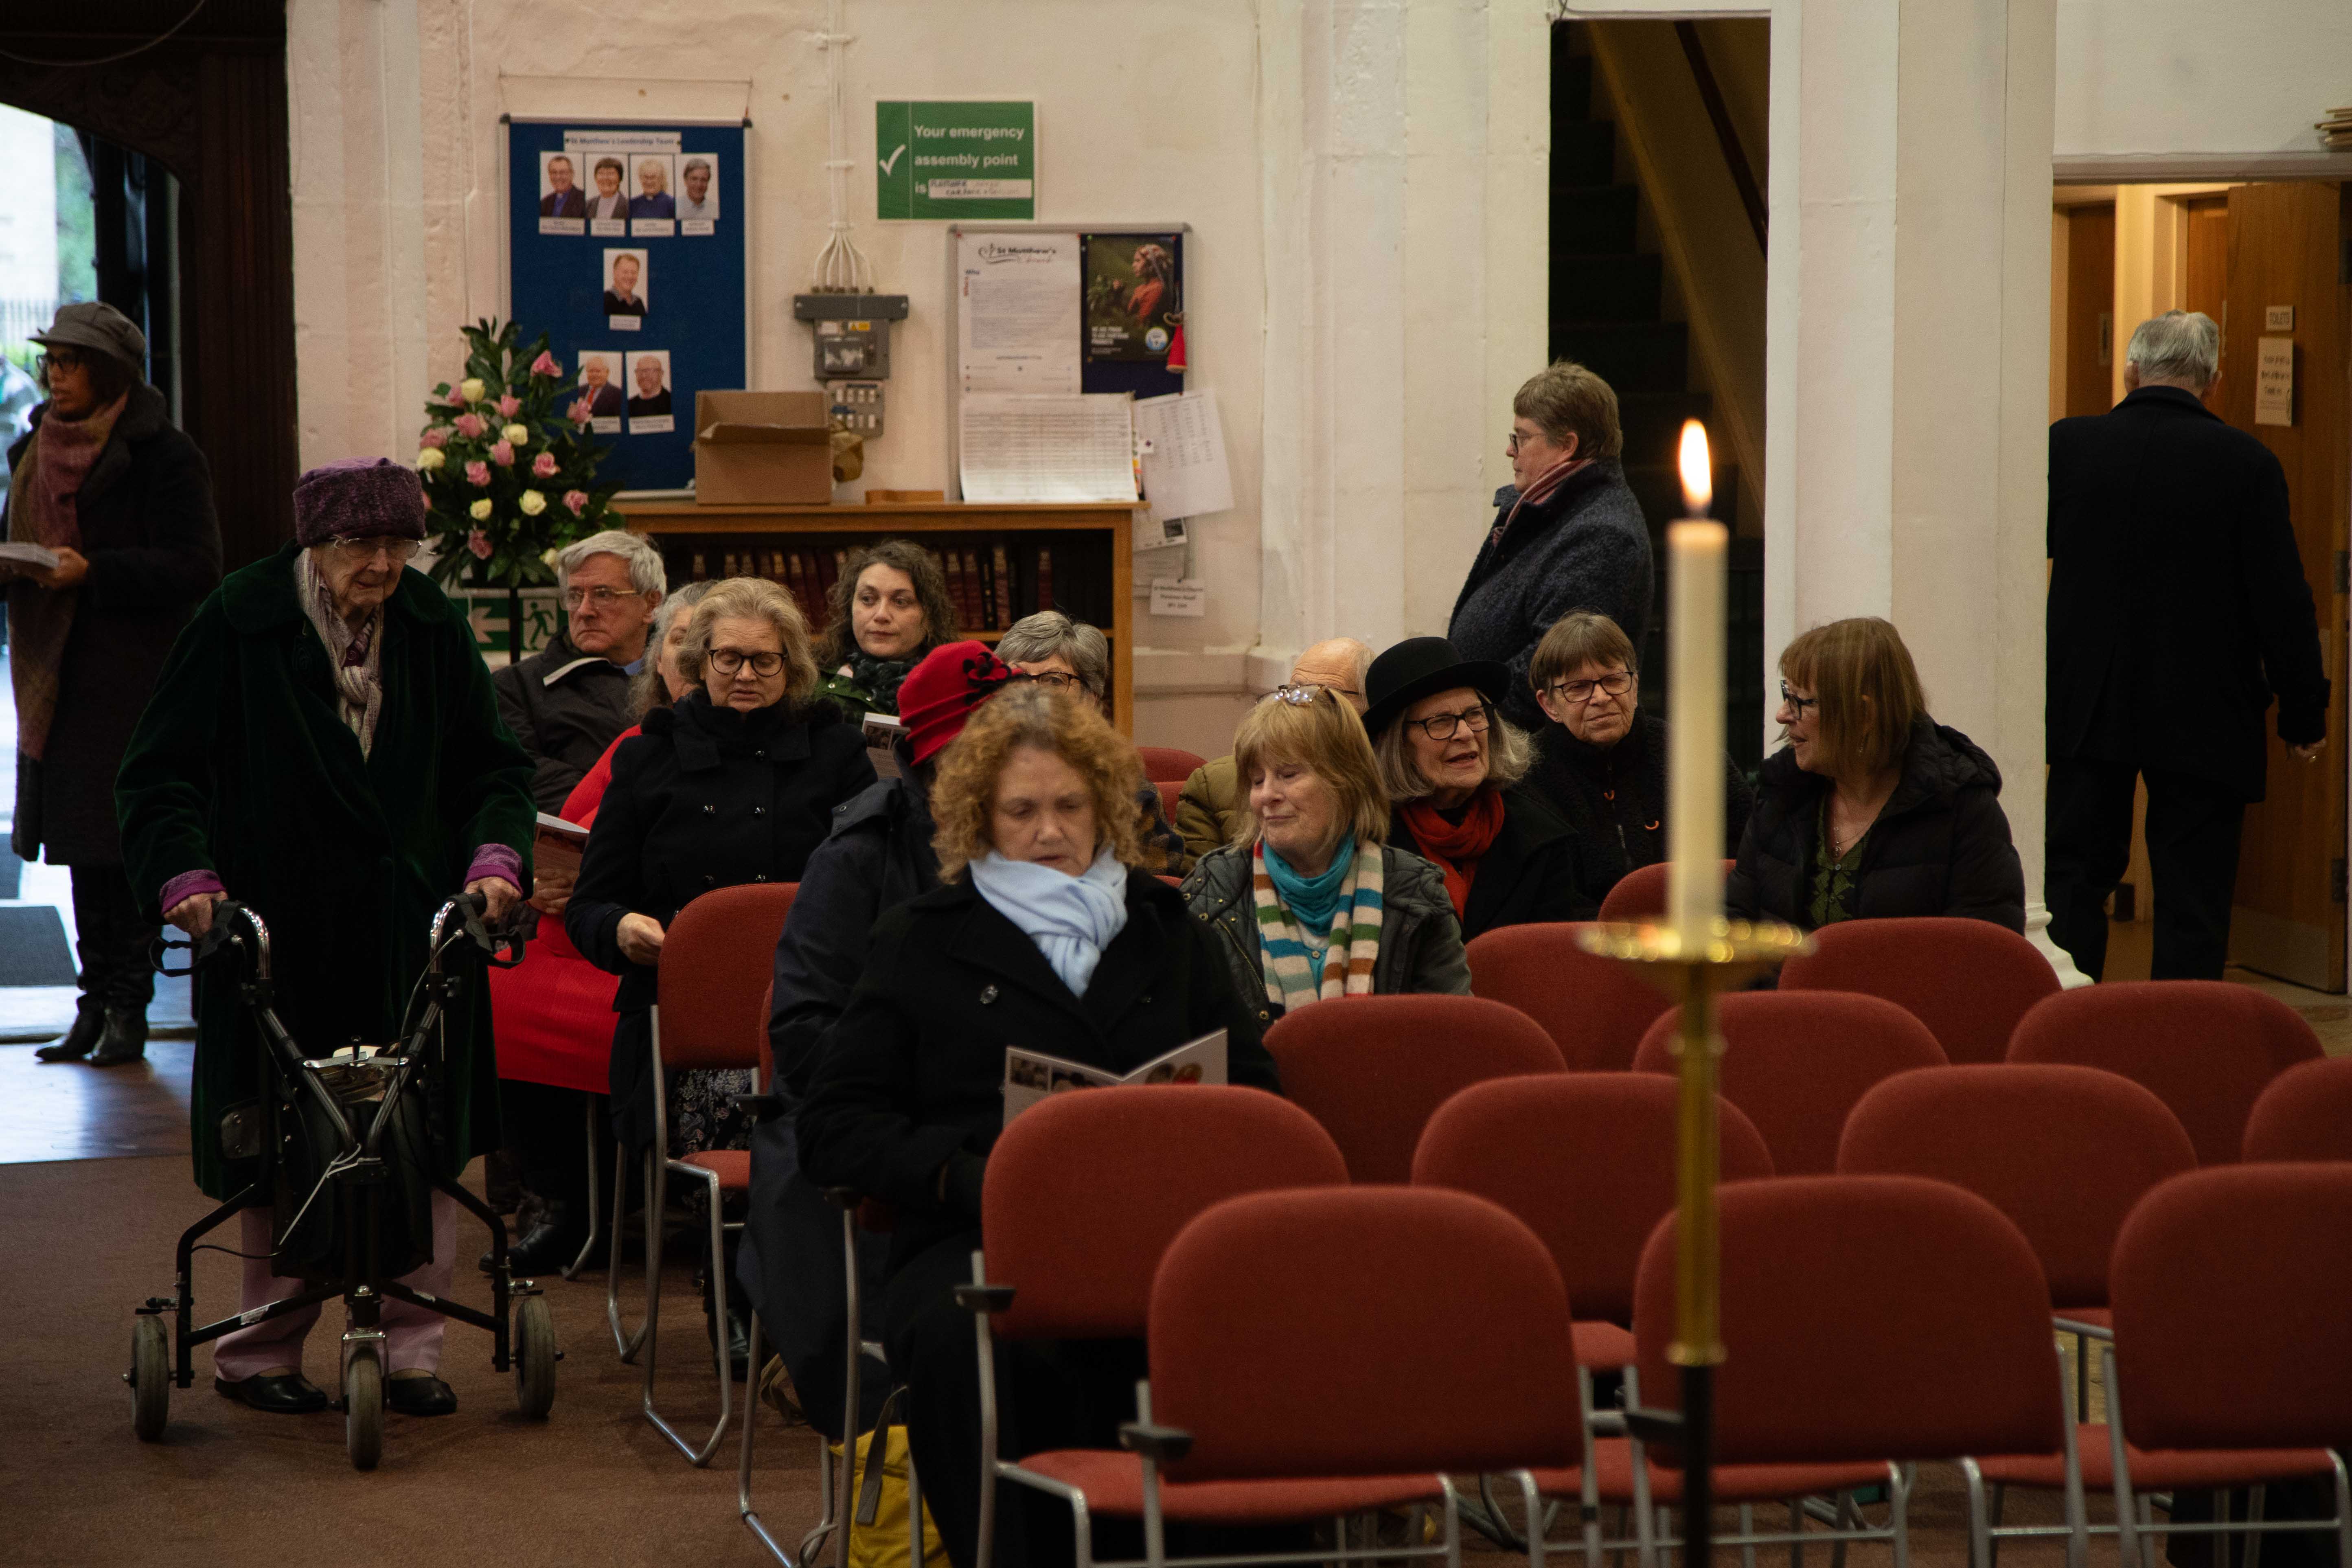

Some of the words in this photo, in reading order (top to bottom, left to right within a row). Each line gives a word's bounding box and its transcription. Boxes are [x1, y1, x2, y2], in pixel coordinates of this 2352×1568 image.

[914, 125, 946, 138] Your
[949, 127, 1025, 141] emergency
[914, 153, 980, 169] assembly
[983, 153, 1019, 169] point
[915, 181, 927, 194] is
